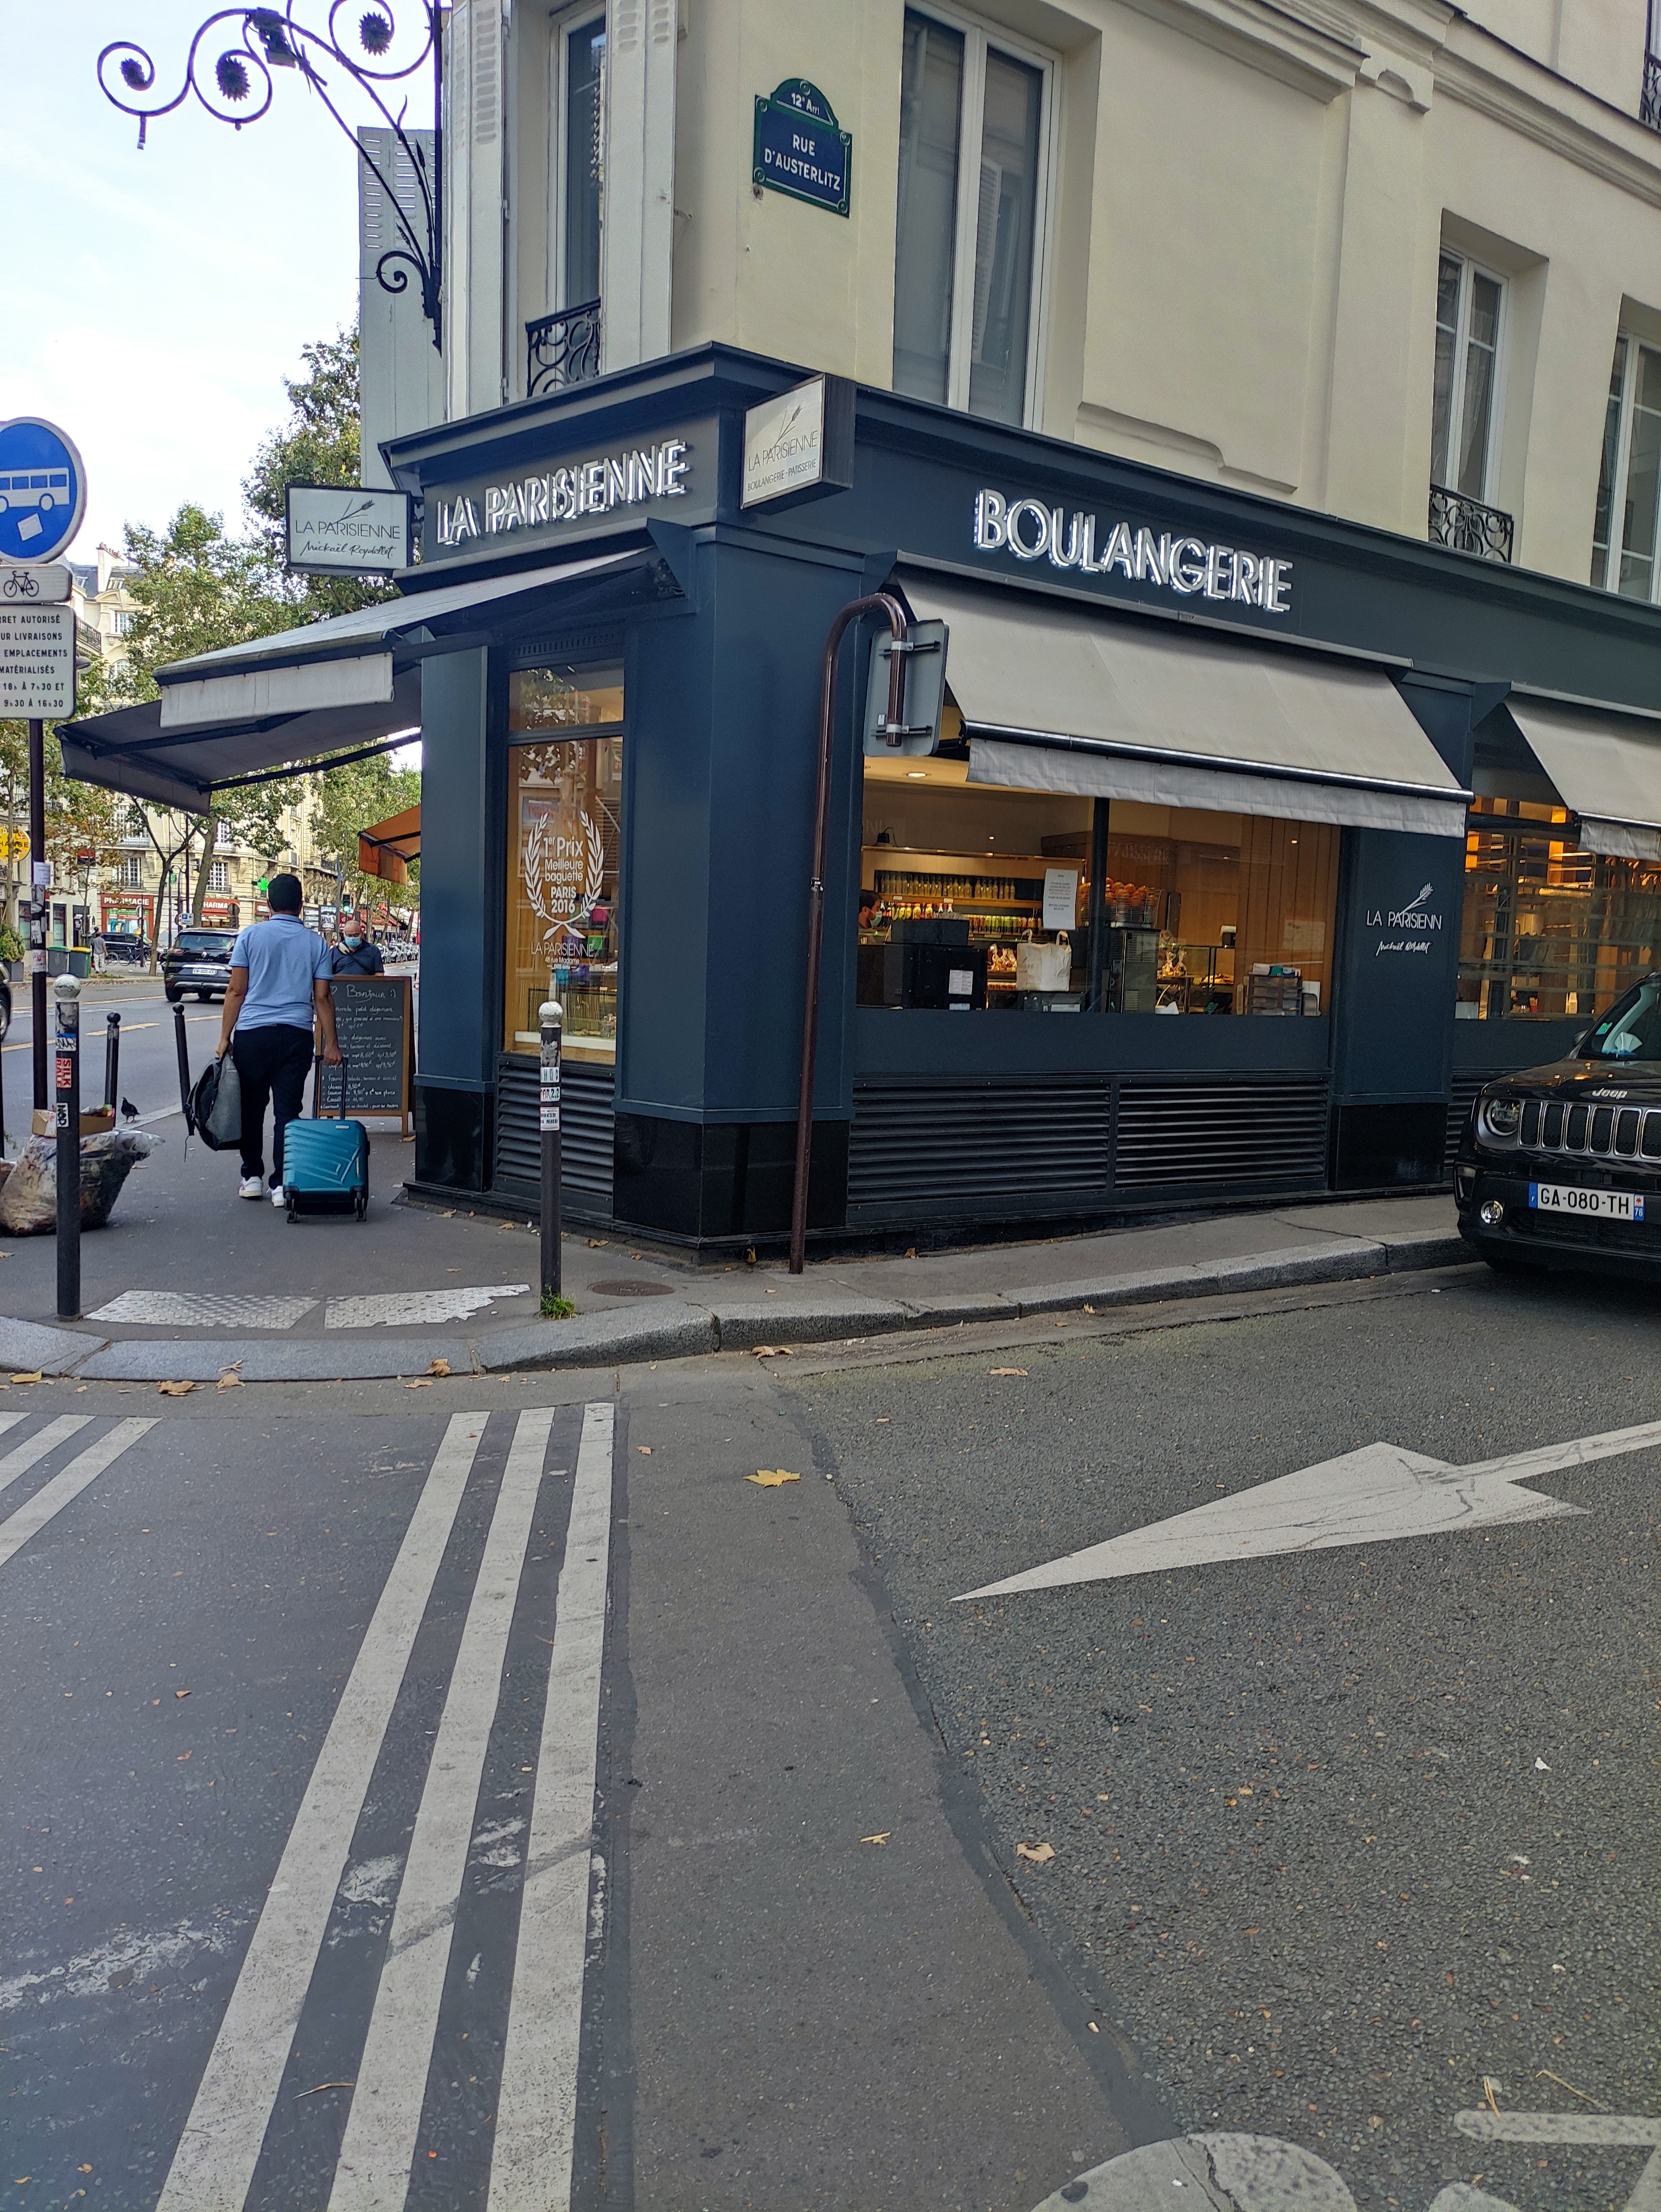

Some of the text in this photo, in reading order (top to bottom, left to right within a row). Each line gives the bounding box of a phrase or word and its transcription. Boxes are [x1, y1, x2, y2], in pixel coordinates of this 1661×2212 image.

[792, 133, 816, 157] RUE
[764, 147, 841, 191] D'AUSTERLITZ
[748, 430, 819, 472] LA PARISIENNE
[747, 469, 785, 492] BOULANGERIE
[788, 458, 817, 477] PATISSERIE
[436, 438, 690, 545] LA PARISIENNE
[295, 519, 400, 540] LA PARISIENNE
[974, 488, 1293, 612] BOULANGERIE
[21, 614, 61, 624] AUTORISÉ
[0, 632, 63, 641] UR LIVRAISONS
[4, 649, 67, 657] EMPLACEMENTS
[55, 683, 65, 691] ET
[557, 836, 584, 858] Prix
[544, 858, 584, 870] Meilleure
[544, 869, 584, 885] baguette
[551, 886, 576, 899] PARIS
[551, 899, 576, 914] 2016
[1366, 909, 1442, 930] LA PARISIENN
[531, 941, 594, 957] LA PARISIENNE
[346, 984, 386, 1003] Bonjour
[63, 1059, 71, 1087] SILK
[1592, 1087, 1628, 1100] Jeep
[1540, 1188, 1629, 1215] GA-080-TH
